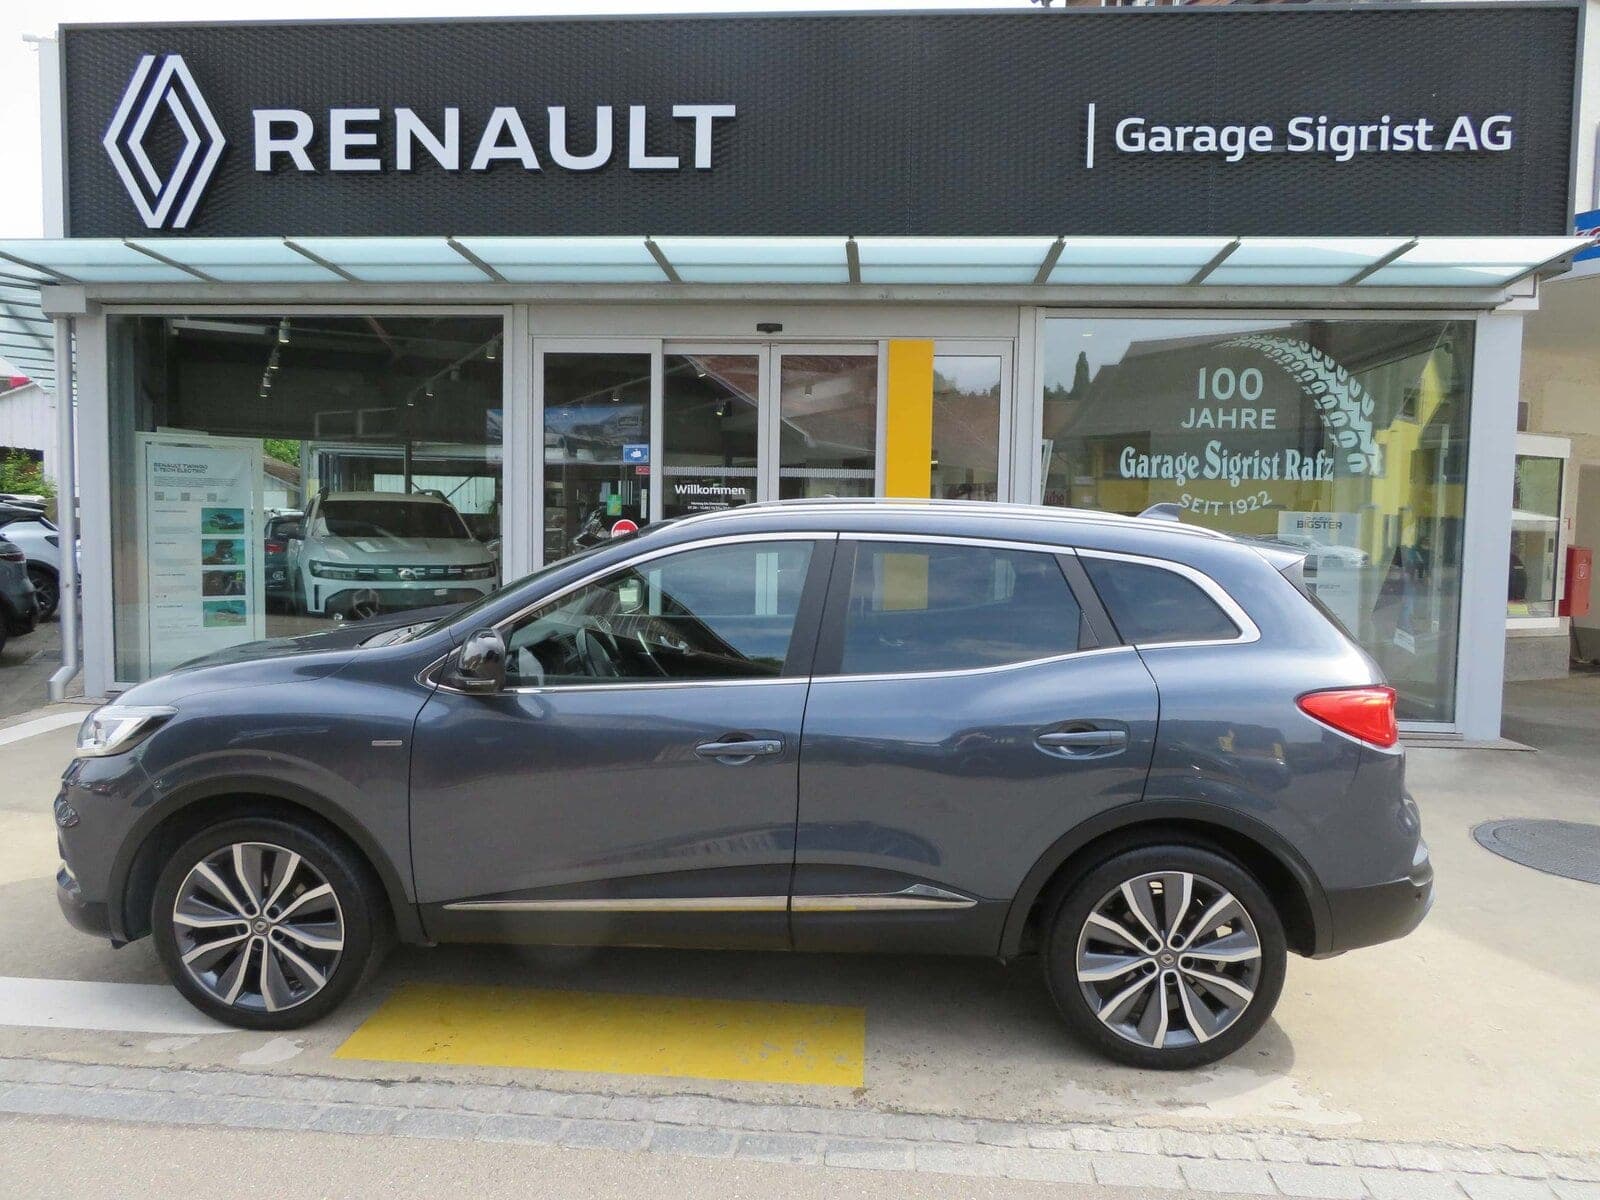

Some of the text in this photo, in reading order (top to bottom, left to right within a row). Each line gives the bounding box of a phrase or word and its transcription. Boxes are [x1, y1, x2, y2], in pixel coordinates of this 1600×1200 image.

[253, 105, 736, 172] RENAULT
[1114, 114, 1513, 163] Garage Sigrist AG
[1198, 367, 1264, 401] 100
[1180, 407, 1277, 430] JAHRE
[1119, 439, 1335, 488] Garage Sigrist Rafz
[674, 484, 746, 495] Willkommen
[1178, 490, 1273, 517] SEIT 1922
[1296, 520, 1343, 530] BIGSTER
